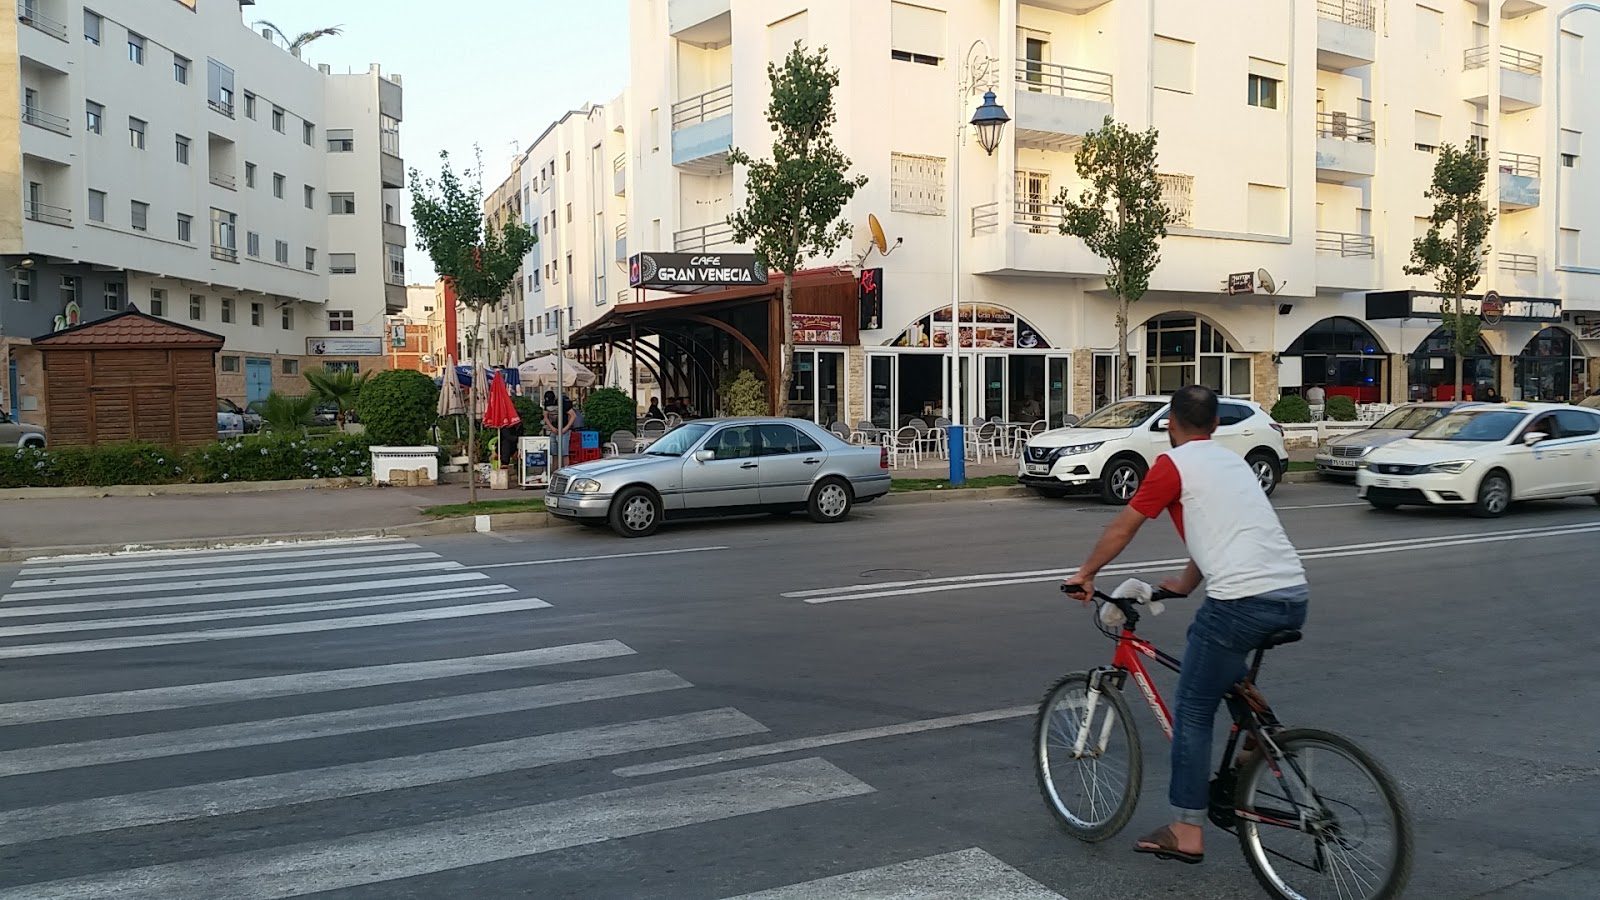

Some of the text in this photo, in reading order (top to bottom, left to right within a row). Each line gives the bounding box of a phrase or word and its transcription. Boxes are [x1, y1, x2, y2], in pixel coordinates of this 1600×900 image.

[690, 256, 721, 266] CAFE
[658, 267, 753, 282] GRAN VENECIA
